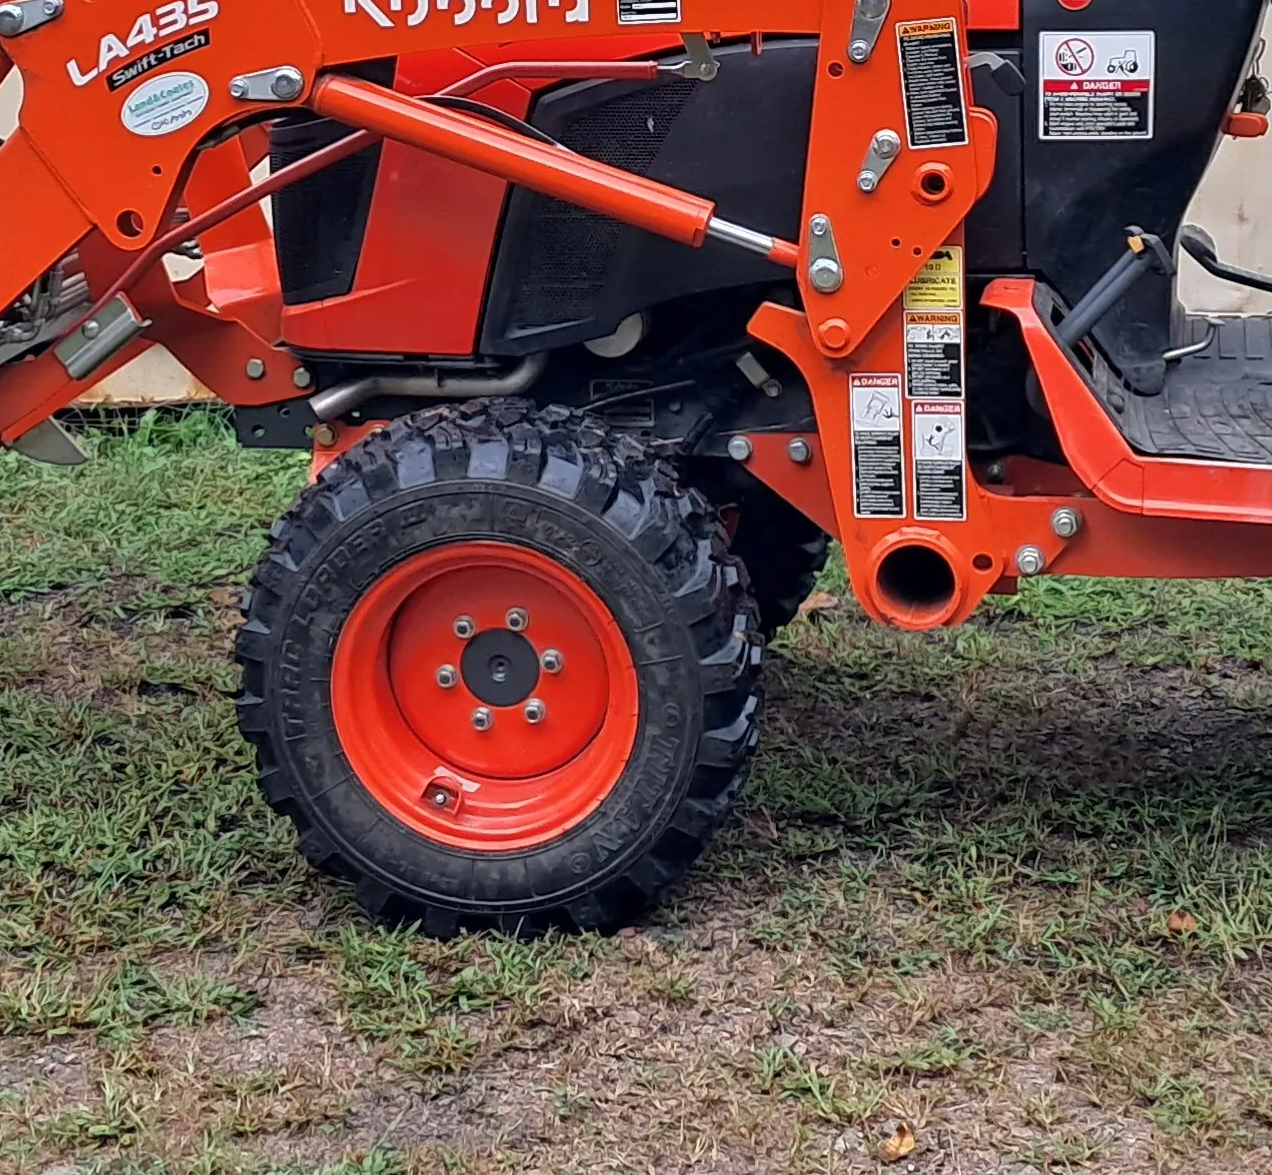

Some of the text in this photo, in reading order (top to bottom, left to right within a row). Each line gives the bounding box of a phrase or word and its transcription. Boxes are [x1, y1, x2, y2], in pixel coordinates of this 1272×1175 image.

[909, 23, 951, 34] WARNING
[111, 33, 206, 88] Swift-Tach
[1082, 81, 1121, 90] DANGER
[916, 314, 958, 323] WARNING
[861, 377, 898, 386] DANGER
[924, 404, 961, 413] DANGER
